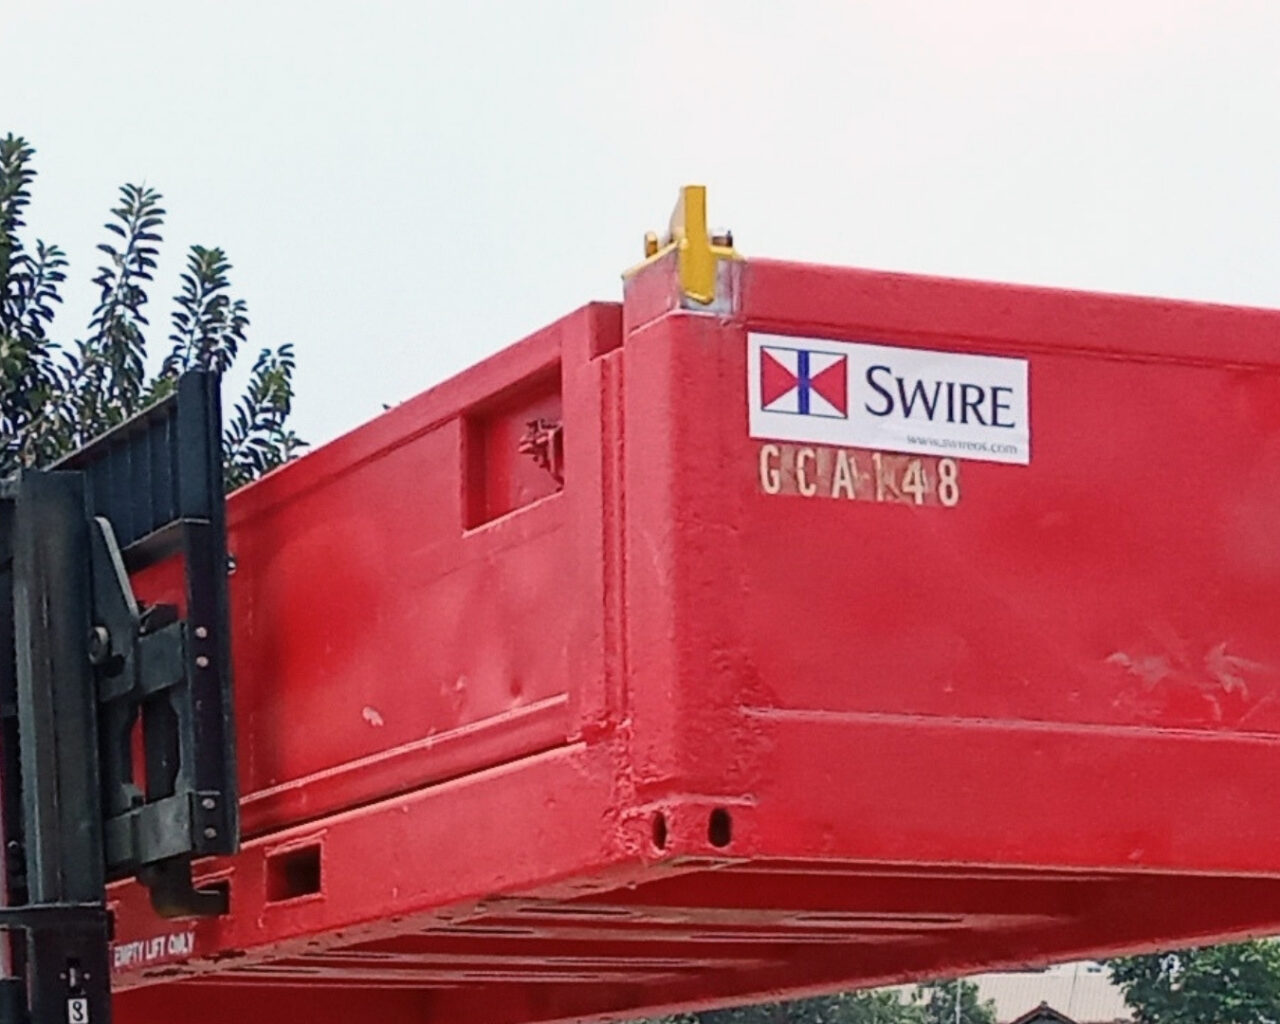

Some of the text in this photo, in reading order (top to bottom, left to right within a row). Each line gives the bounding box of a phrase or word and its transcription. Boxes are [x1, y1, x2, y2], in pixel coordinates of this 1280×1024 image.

[864, 365, 1016, 429] SWIRE
[114, 932, 195, 967] EMPTY LIFT ONLY
